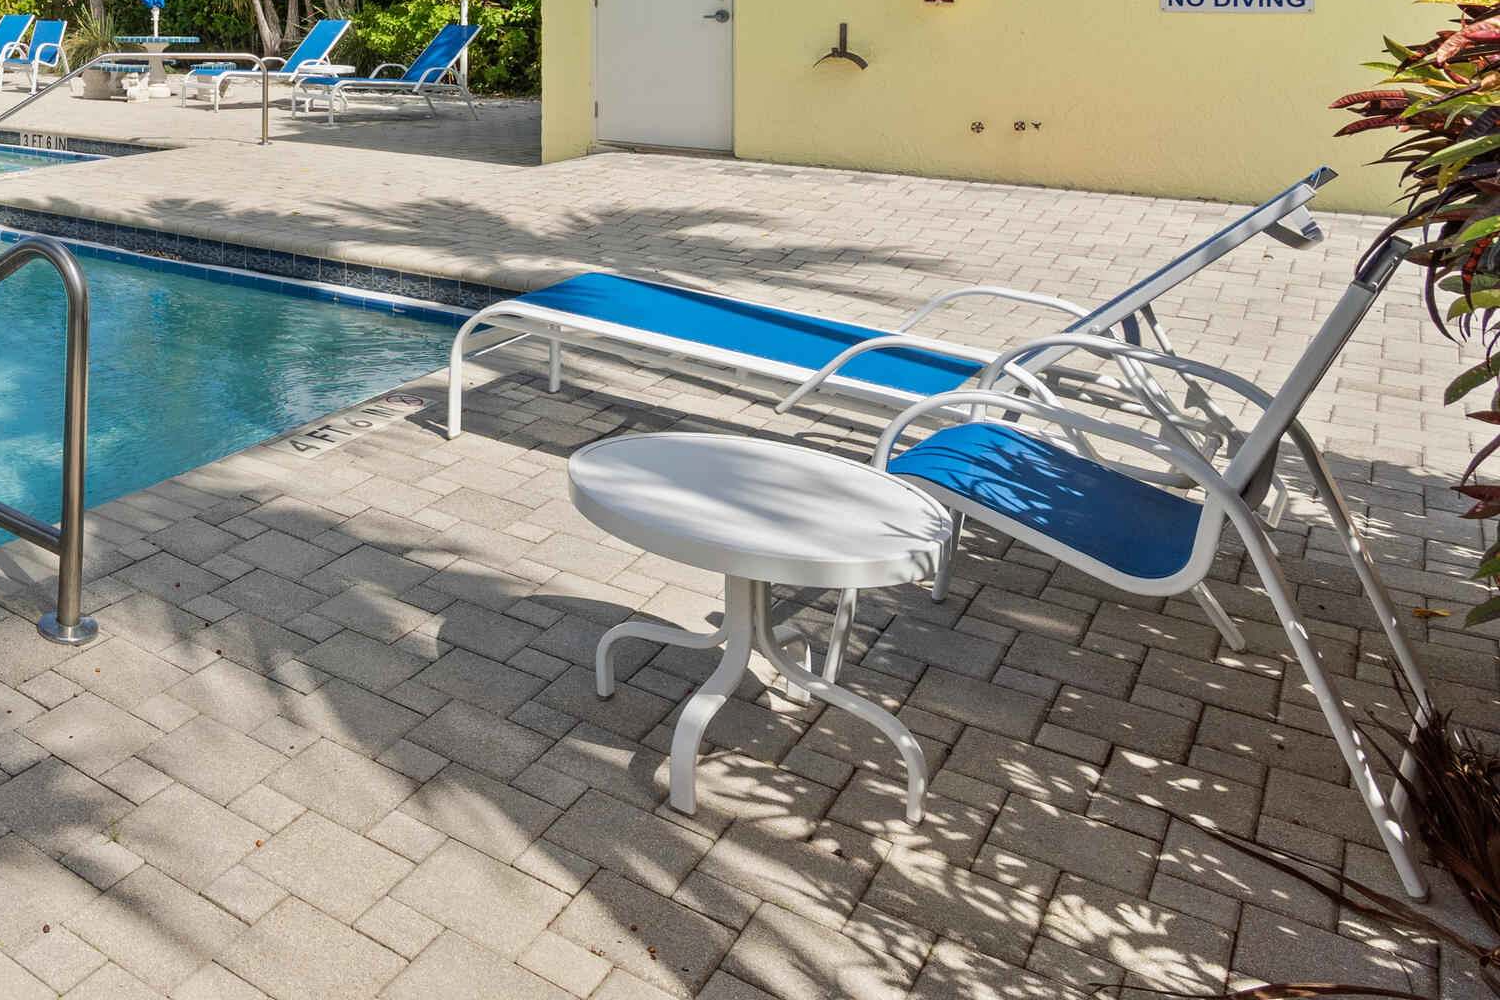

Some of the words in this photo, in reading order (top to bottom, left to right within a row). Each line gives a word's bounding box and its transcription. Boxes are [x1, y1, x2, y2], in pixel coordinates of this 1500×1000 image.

[23, 134, 29, 146] 3
[32, 134, 43, 148] FT
[46, 136, 51, 149] 6
[55, 136, 66, 150] IN
[288, 439, 321, 452] 4
[305, 424, 352, 443] FT
[344, 417, 373, 428] 6
[361, 404, 405, 419] IN
